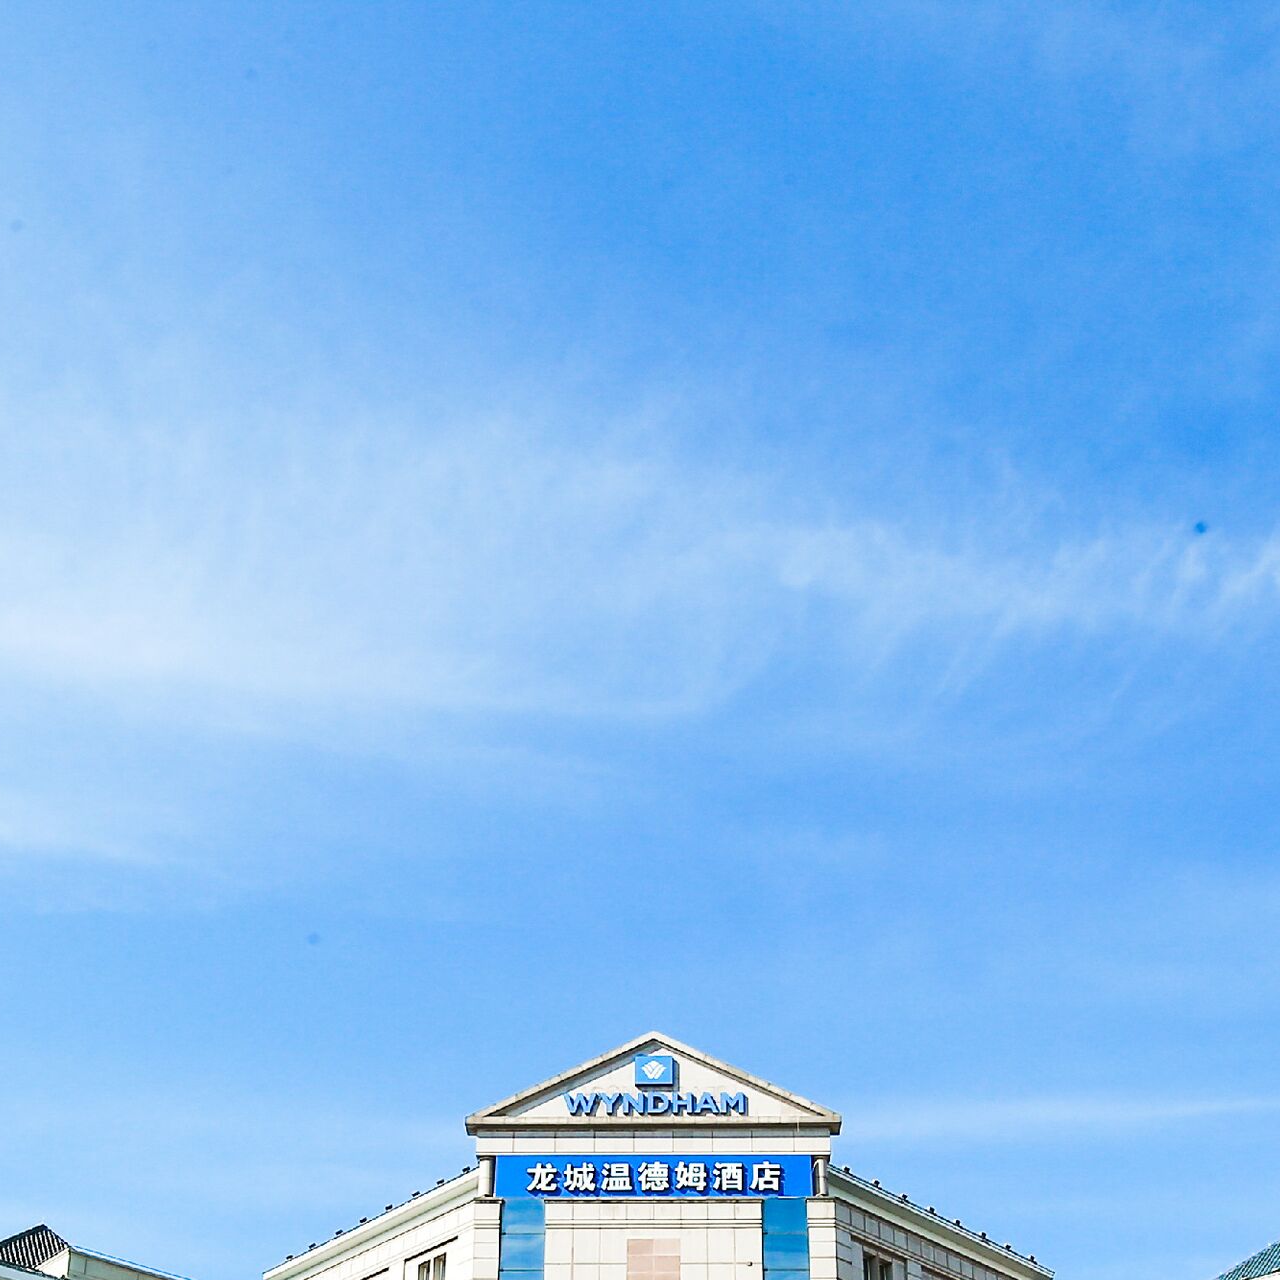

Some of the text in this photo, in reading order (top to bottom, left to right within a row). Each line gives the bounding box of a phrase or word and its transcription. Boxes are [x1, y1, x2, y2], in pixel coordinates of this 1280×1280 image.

[564, 1091, 747, 1116] WYNDHAM
[526, 1161, 782, 1193] 龙城温德姆酒店
